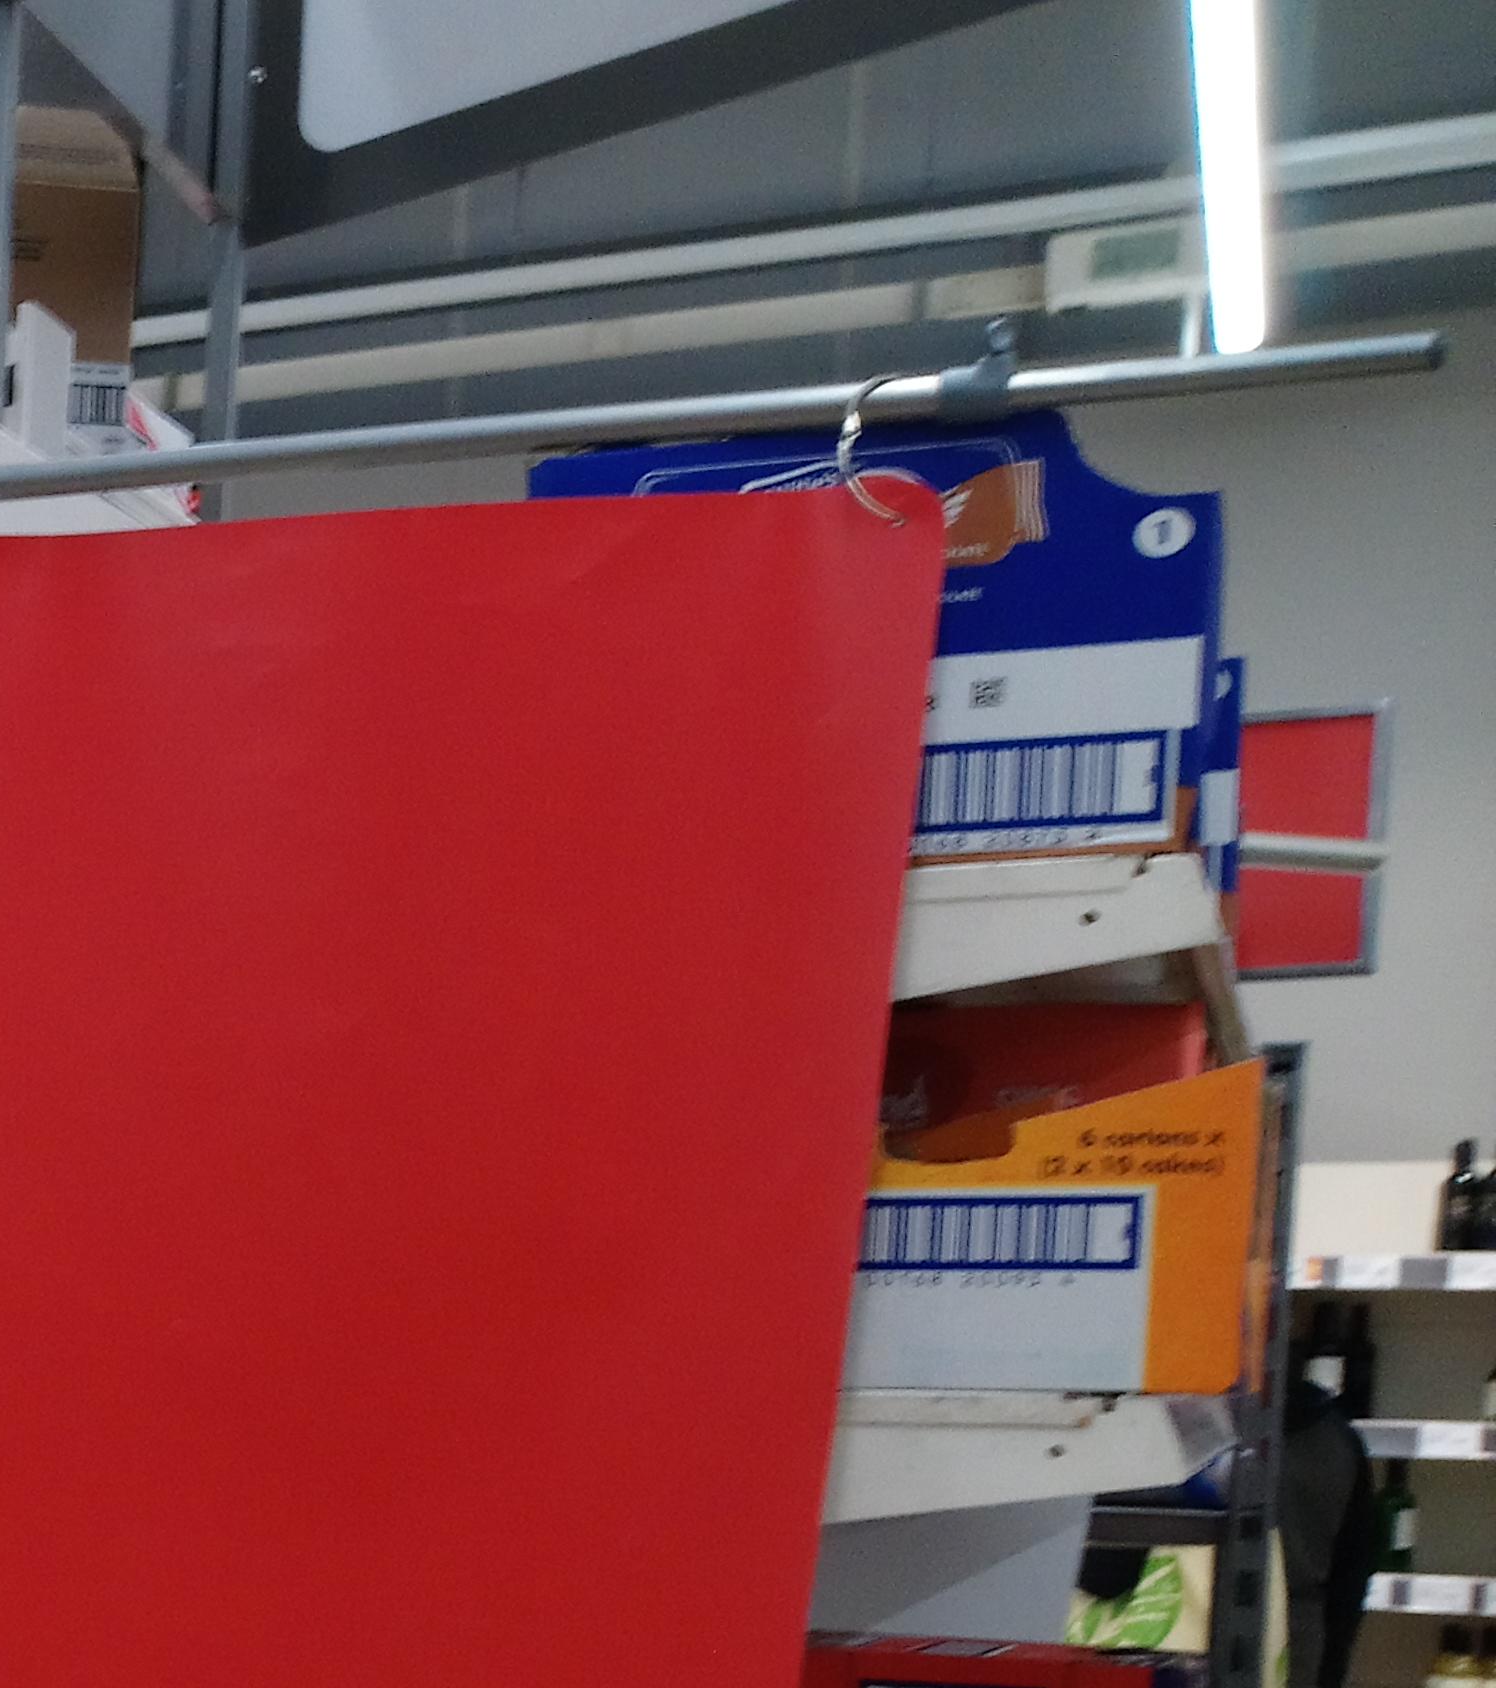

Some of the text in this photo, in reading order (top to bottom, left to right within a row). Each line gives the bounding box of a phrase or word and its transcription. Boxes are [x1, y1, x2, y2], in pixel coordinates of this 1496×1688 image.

[1079, 1126, 1098, 1148] 6
[1204, 1130, 1225, 1148] x
[1070, 1159, 1093, 1177] x
